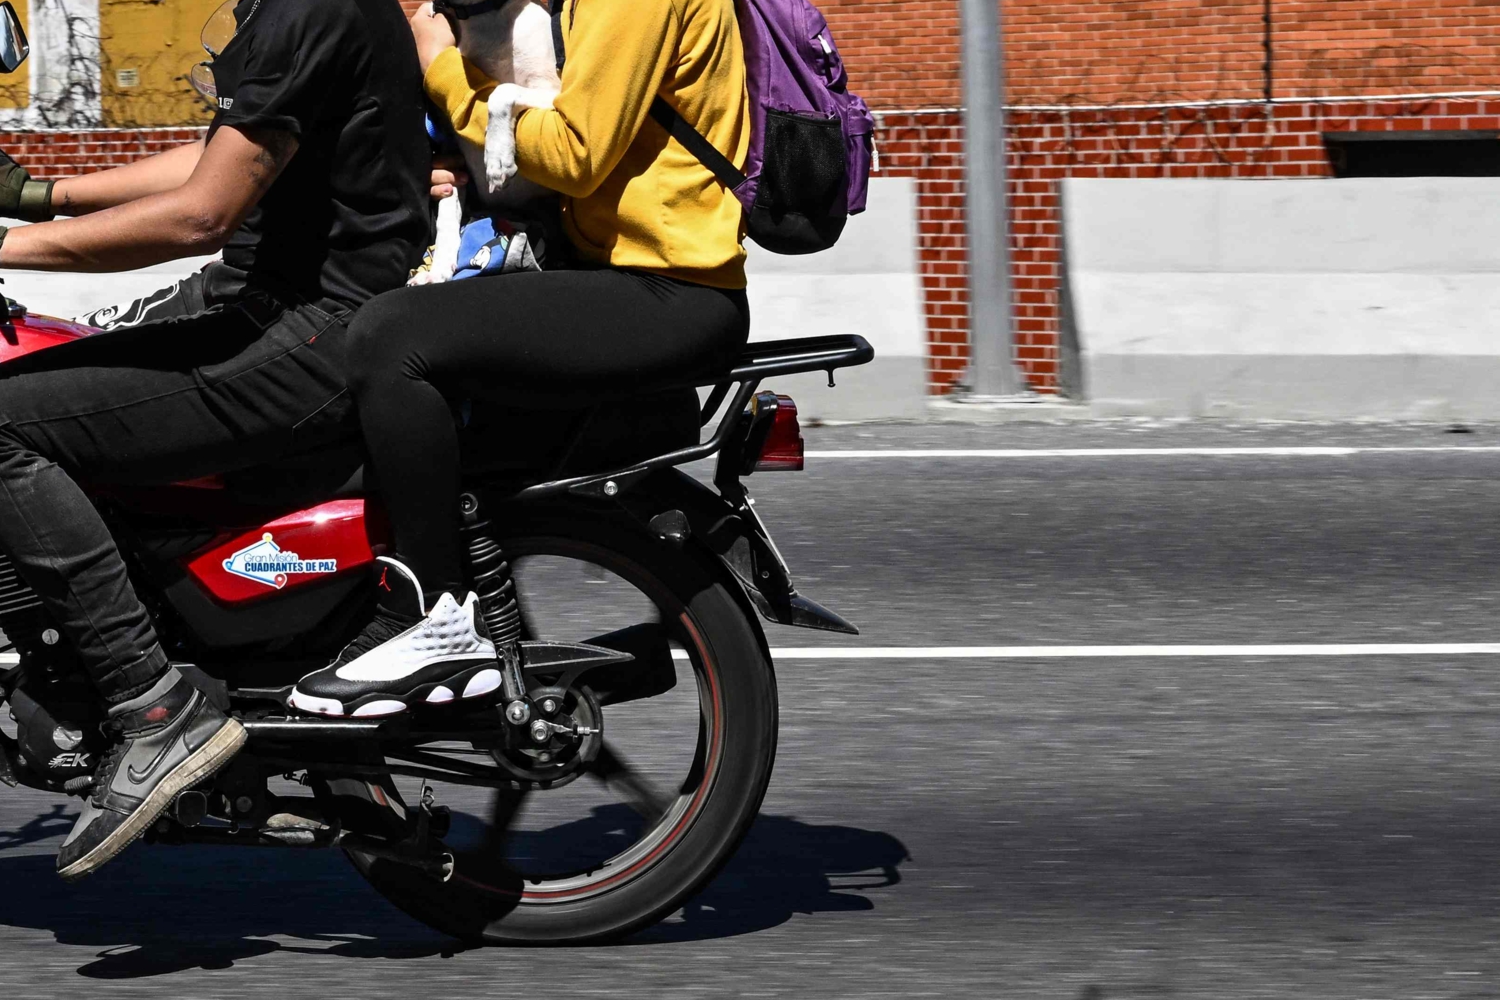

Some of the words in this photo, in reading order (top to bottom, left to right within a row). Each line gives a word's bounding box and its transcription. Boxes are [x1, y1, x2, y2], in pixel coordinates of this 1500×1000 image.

[243, 552, 267, 563] Gran
[268, 552, 298, 562] Misión
[244, 562, 304, 572] CUADRANTES
[306, 562, 317, 572] DE
[318, 561, 335, 571] PAZ
